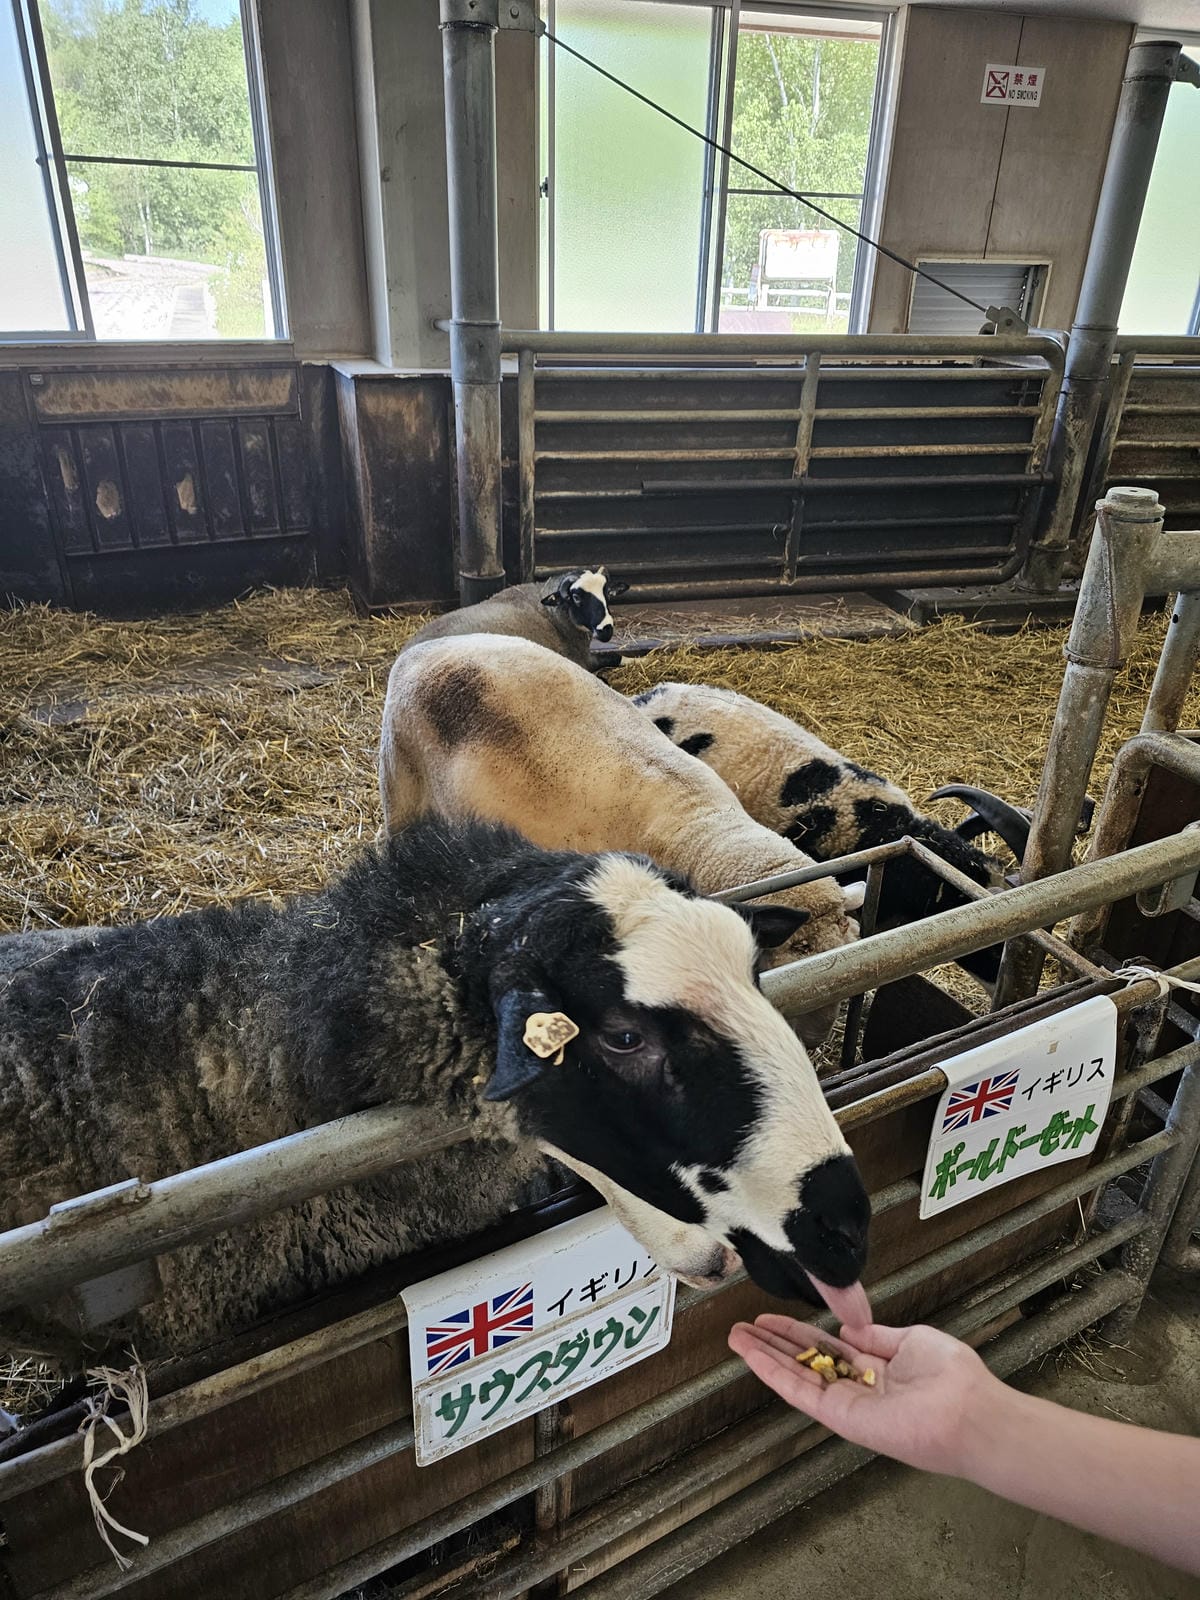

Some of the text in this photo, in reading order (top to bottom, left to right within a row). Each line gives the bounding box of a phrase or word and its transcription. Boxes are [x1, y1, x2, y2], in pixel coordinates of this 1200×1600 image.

[1013, 73, 1038, 86] 禁煙
[1008, 90, 1038, 100] NO SMOKING
[1021, 1057, 1105, 1101] イギリス
[435, 1305, 660, 1438] サウスダウン
